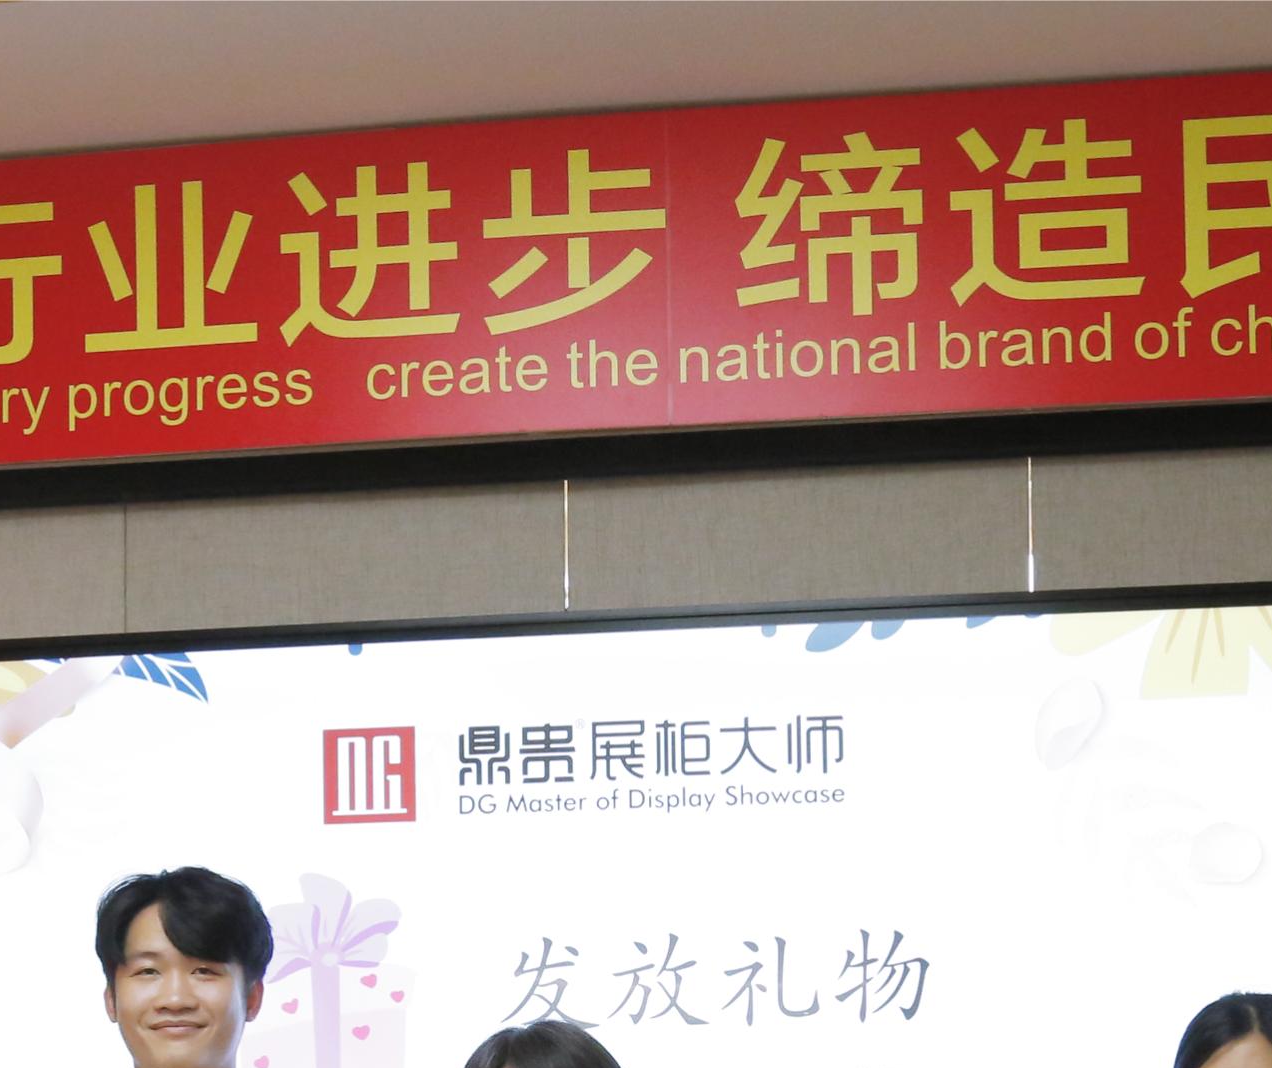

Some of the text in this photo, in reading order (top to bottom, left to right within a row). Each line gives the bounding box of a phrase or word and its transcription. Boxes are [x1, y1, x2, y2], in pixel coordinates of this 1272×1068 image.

[68, 368, 313, 433] progress
[365, 348, 548, 400] create
[570, 340, 658, 387] the
[678, 322, 917, 383] national
[938, 311, 1112, 369] brand
[1134, 306, 1194, 360] of
[458, 783, 845, 815] DG Master of Display Showcase
[500, 928, 930, 1031] 发放礼物
